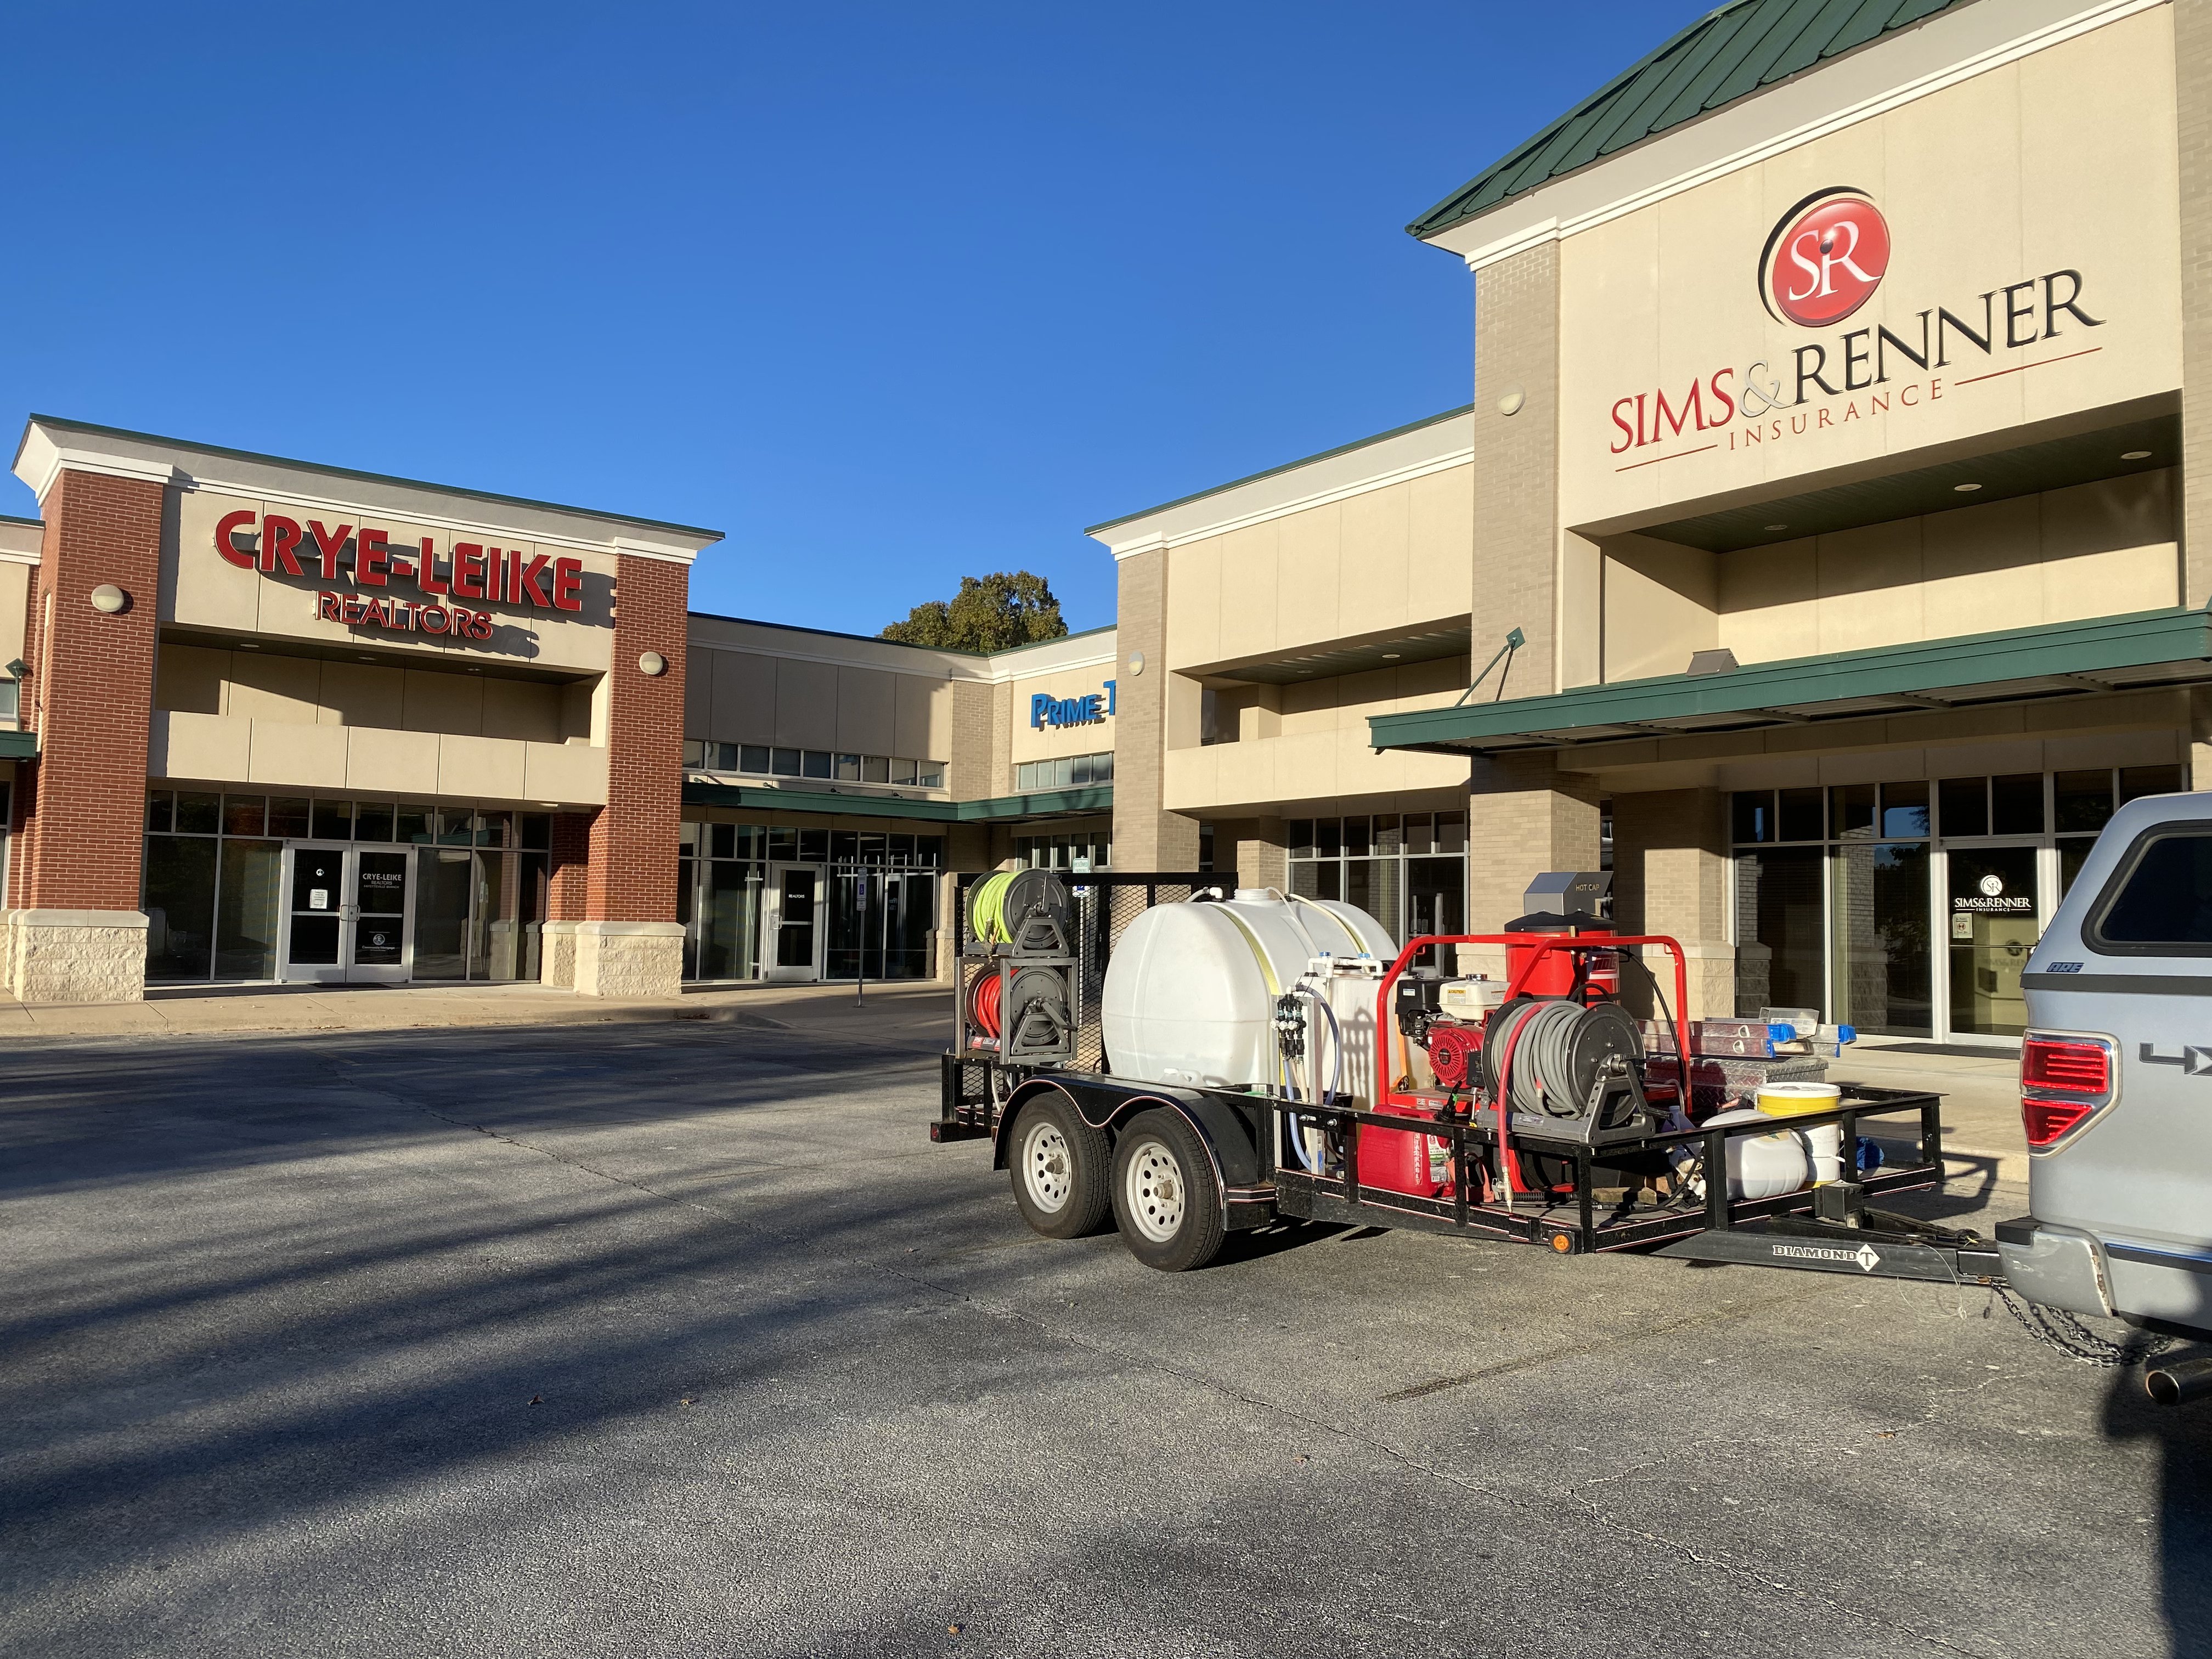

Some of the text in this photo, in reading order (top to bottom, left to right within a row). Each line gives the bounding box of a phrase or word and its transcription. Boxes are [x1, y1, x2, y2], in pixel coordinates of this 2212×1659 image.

[1729, 377, 1945, 451] INSURANCE
[213, 510, 583, 611] CRYE-LEIKE
[314, 590, 493, 640] REALTORS
[1031, 693, 1102, 728] PRIME
[362, 873, 402, 881] CRYE-LEIKE
[1588, 883, 1600, 891] CAP
[1772, 1244, 1859, 1262] DIAMOND
